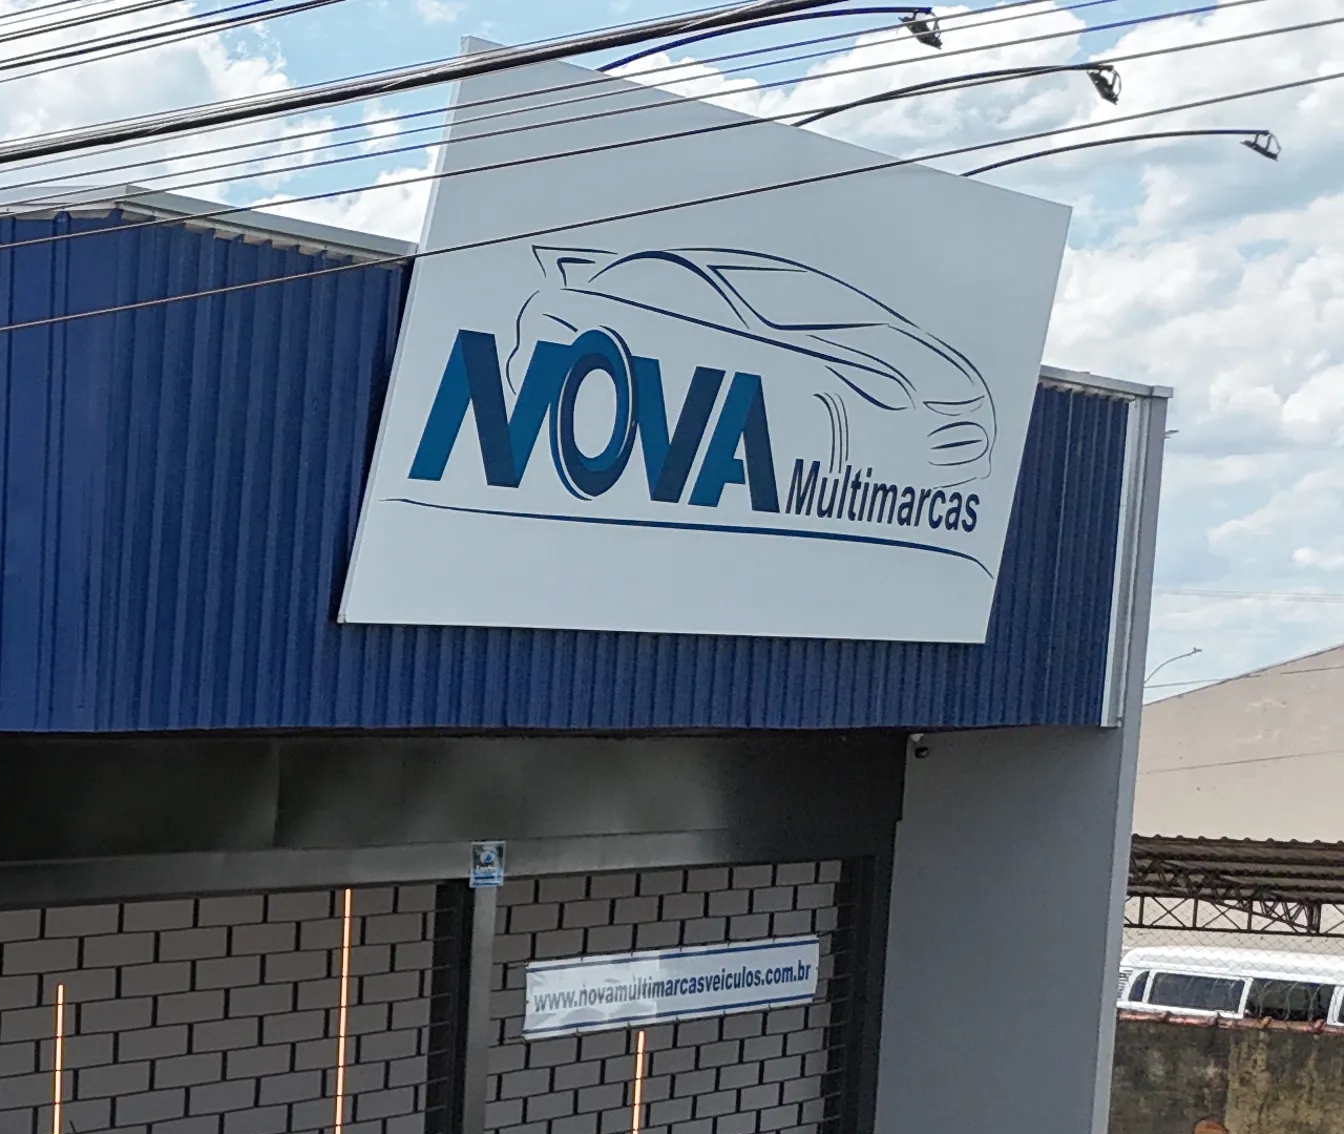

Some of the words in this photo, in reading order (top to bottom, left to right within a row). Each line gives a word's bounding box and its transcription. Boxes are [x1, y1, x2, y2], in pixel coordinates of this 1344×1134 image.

[408, 327, 780, 513] NOVA
[785, 458, 981, 533] Multimarcas
[533, 959, 812, 1012] www.novamultimarcasveiculos.com.br
